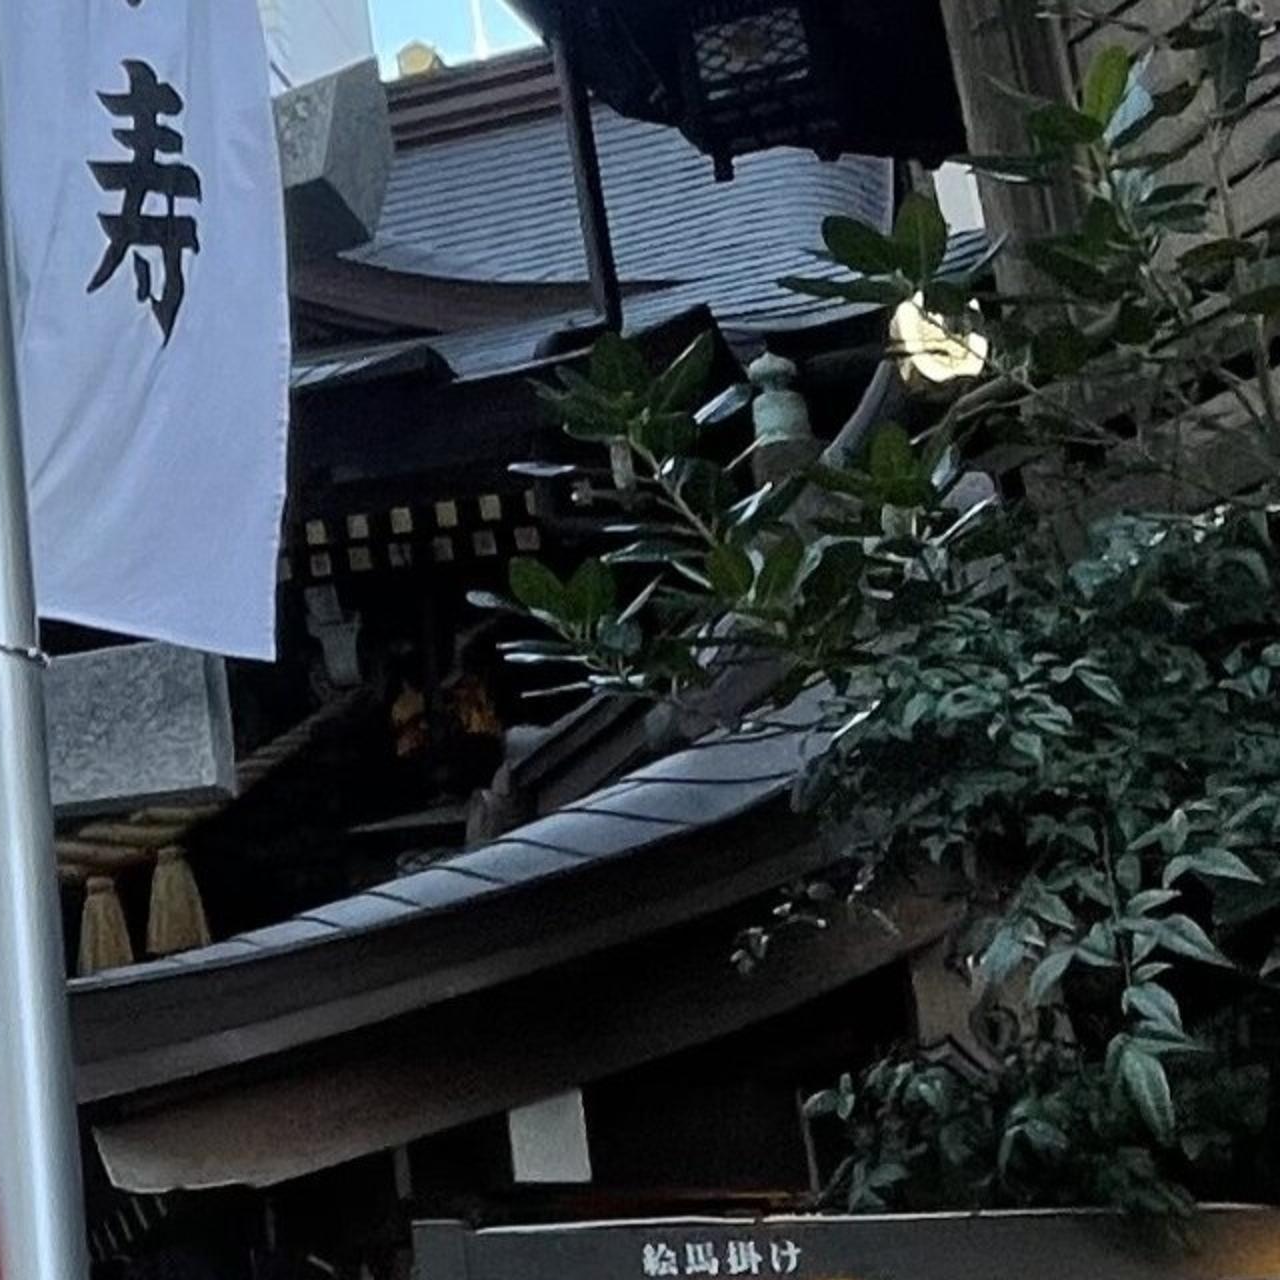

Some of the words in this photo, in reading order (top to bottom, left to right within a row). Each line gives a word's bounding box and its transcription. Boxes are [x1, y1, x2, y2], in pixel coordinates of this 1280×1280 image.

[86, 0, 202, 348] 寿
[642, 1240, 802, 1277] 絵馬掛け
